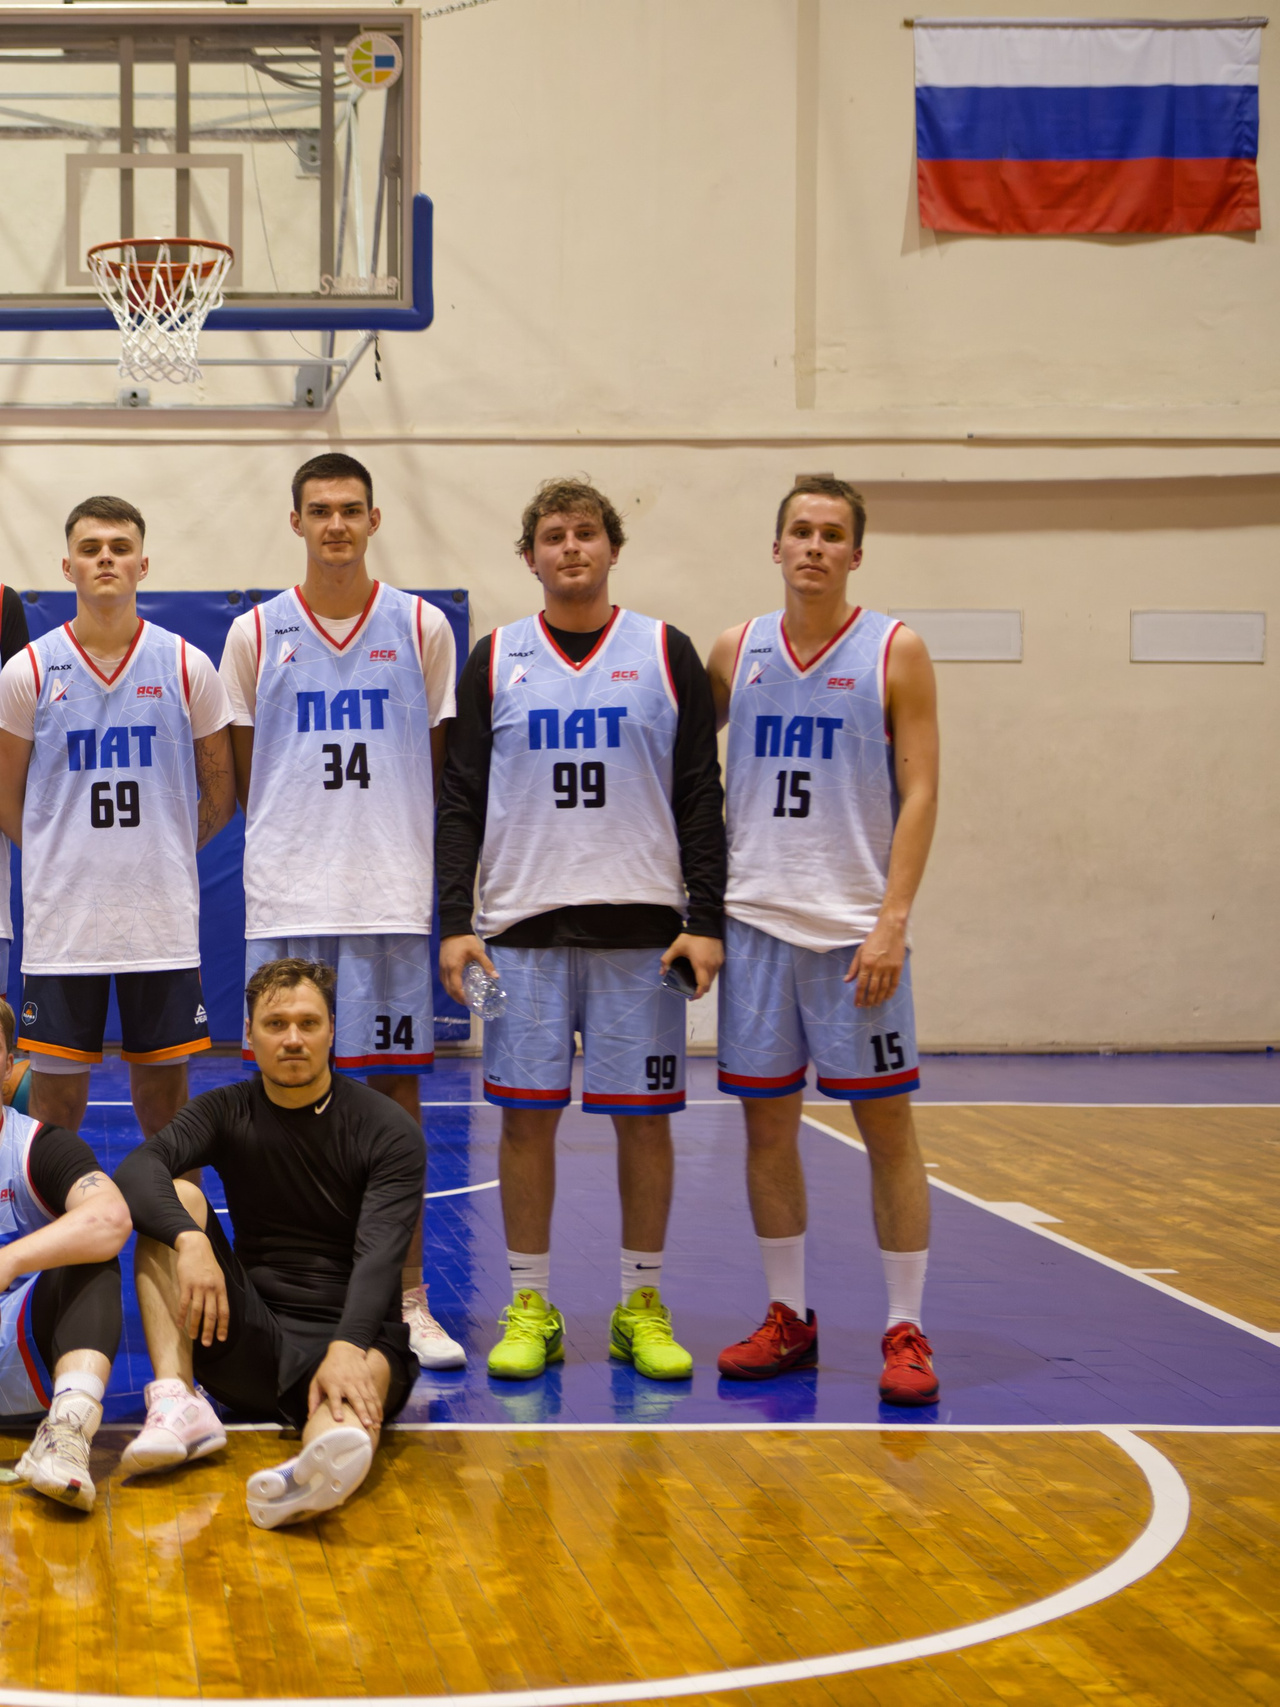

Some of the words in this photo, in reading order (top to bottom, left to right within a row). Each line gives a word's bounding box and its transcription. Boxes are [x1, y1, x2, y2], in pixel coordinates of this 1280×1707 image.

[275, 626, 299, 635] MAXX
[296, 688, 389, 733] ПАТ
[528, 706, 627, 750] ПАТ
[66, 725, 157, 772] ПАТ
[754, 715, 844, 760] ПАТ
[322, 742, 371, 790] 34
[553, 761, 606, 809] 99
[90, 780, 141, 829] 69
[773, 770, 811, 818] 15
[374, 1015, 414, 1051] 34
[870, 1031, 905, 1074] 15
[646, 1054, 676, 1091] 99
